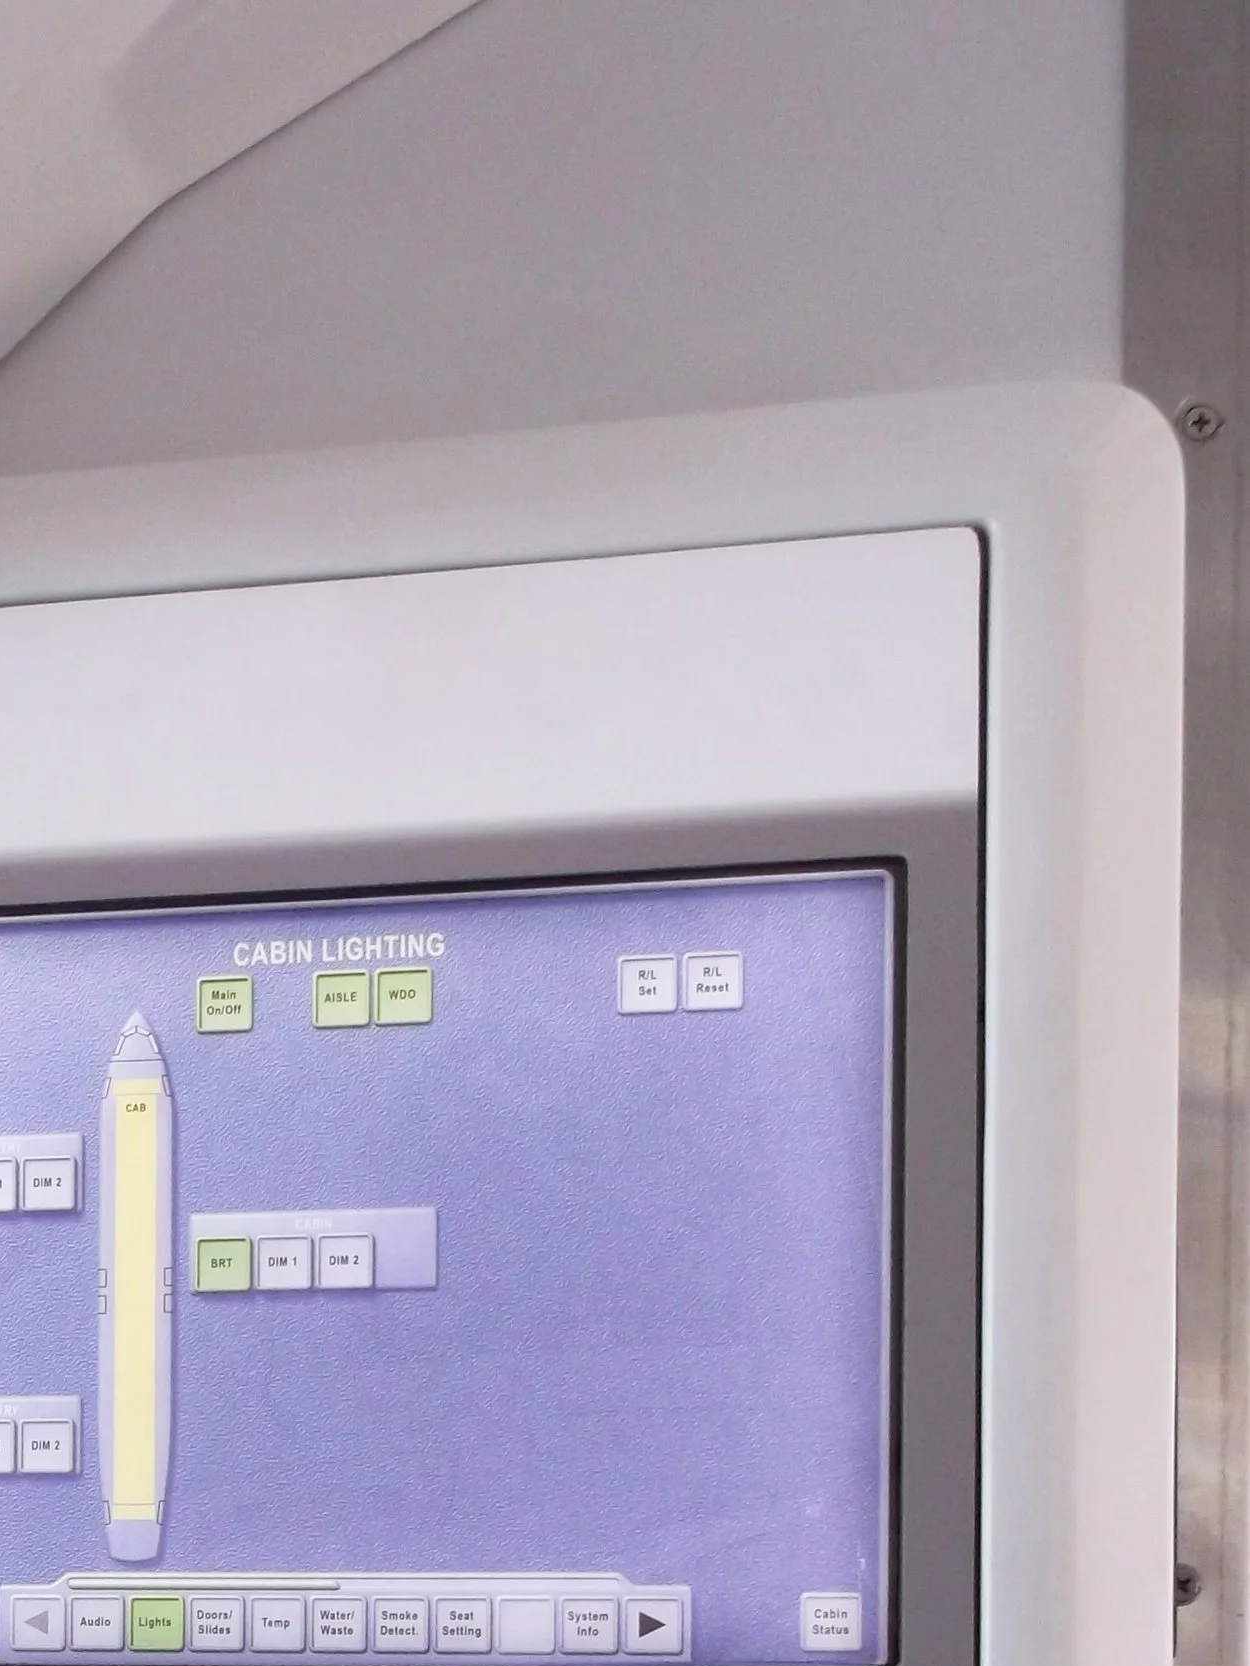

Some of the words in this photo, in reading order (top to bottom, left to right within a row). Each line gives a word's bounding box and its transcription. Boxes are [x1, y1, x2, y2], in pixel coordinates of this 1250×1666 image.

[233, 939, 313, 967] CABIN
[322, 932, 445, 963] LIGHTING
[638, 969, 657, 981] R/L
[702, 966, 722, 977] R/L
[638, 985, 657, 996] Set
[696, 982, 729, 993] Reset
[211, 990, 237, 1000] Main
[324, 991, 357, 1003] AISLE
[388, 988, 417, 1001] WDO
[206, 1004, 242, 1016] On/Off
[125, 1102, 147, 1113] CAB
[32, 1177, 53, 1188] DIM
[294, 1217, 333, 1230] CABIN
[210, 1257, 233, 1269] BRT
[268, 1256, 288, 1267] DIM
[329, 1255, 349, 1266] DIM
[31, 1440, 51, 1451] DIM
[196, 1609, 233, 1620] Doors/
[319, 1610, 355, 1621] Water/
[381, 1610, 418, 1621] Smoke
[449, 1610, 474, 1621] Seat
[567, 1610, 609, 1624] System
[814, 1608, 848, 1619] Cabin
[79, 1616, 111, 1627] Audio
[138, 1616, 172, 1630] Lights
[261, 1616, 291, 1630] Temp
[198, 1624, 231, 1635] Slides
[320, 1624, 354, 1636] Waste
[380, 1625, 420, 1637] Detect.
[441, 1625, 482, 1639] Setting
[577, 1626, 599, 1637] Info
[812, 1624, 850, 1635] Status
